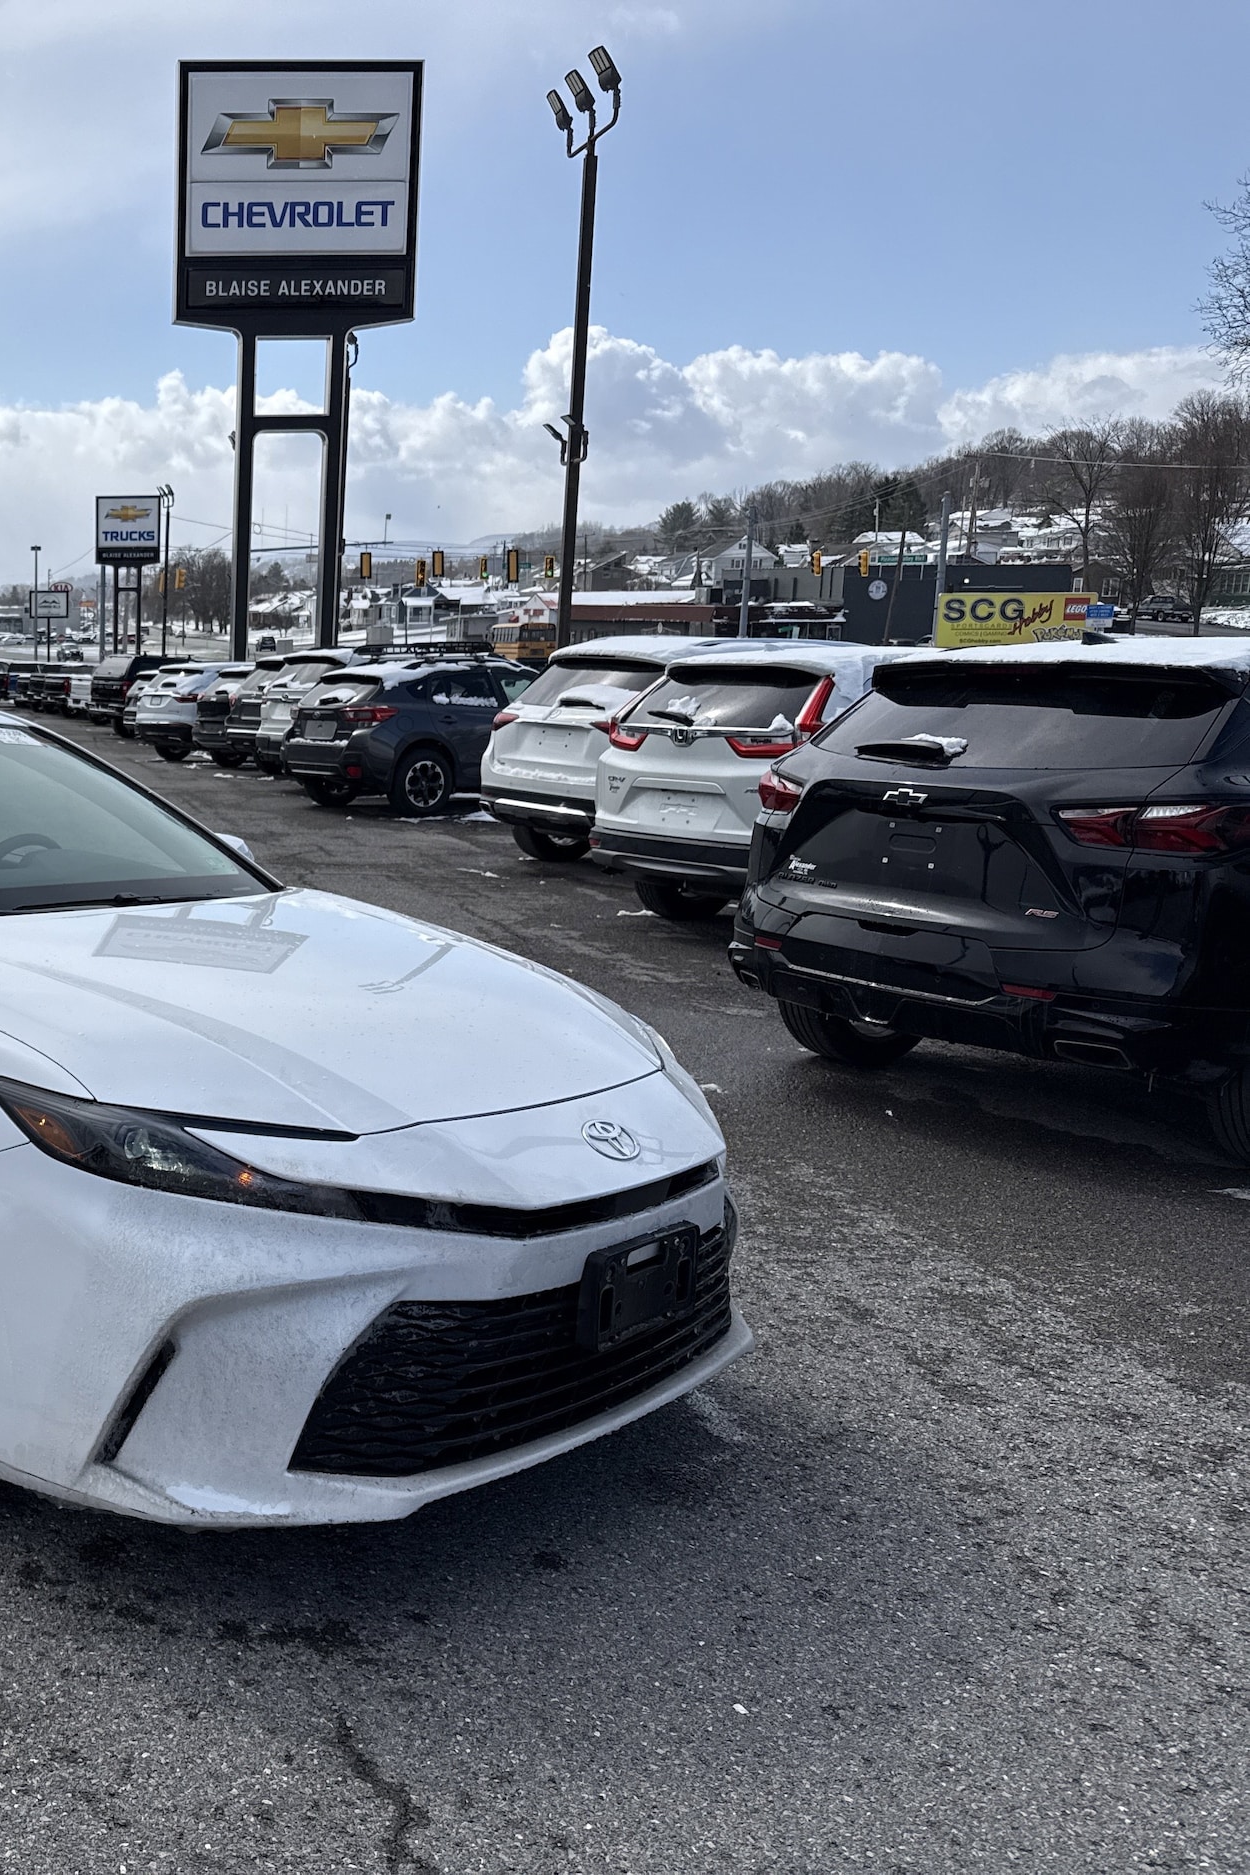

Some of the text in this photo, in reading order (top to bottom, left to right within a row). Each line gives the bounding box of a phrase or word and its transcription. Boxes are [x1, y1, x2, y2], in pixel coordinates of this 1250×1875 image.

[201, 200, 395, 228] CHEVROLET
[205, 279, 386, 296] BLAISE ALEXANDER
[102, 530, 155, 542] TRUCKS
[53, 584, 68, 592] KIA
[942, 597, 1025, 623] SCG
[1066, 604, 1088, 614] LEGO
[1006, 598, 1055, 636] Hobby
[1024, 908, 1060, 919] RS
